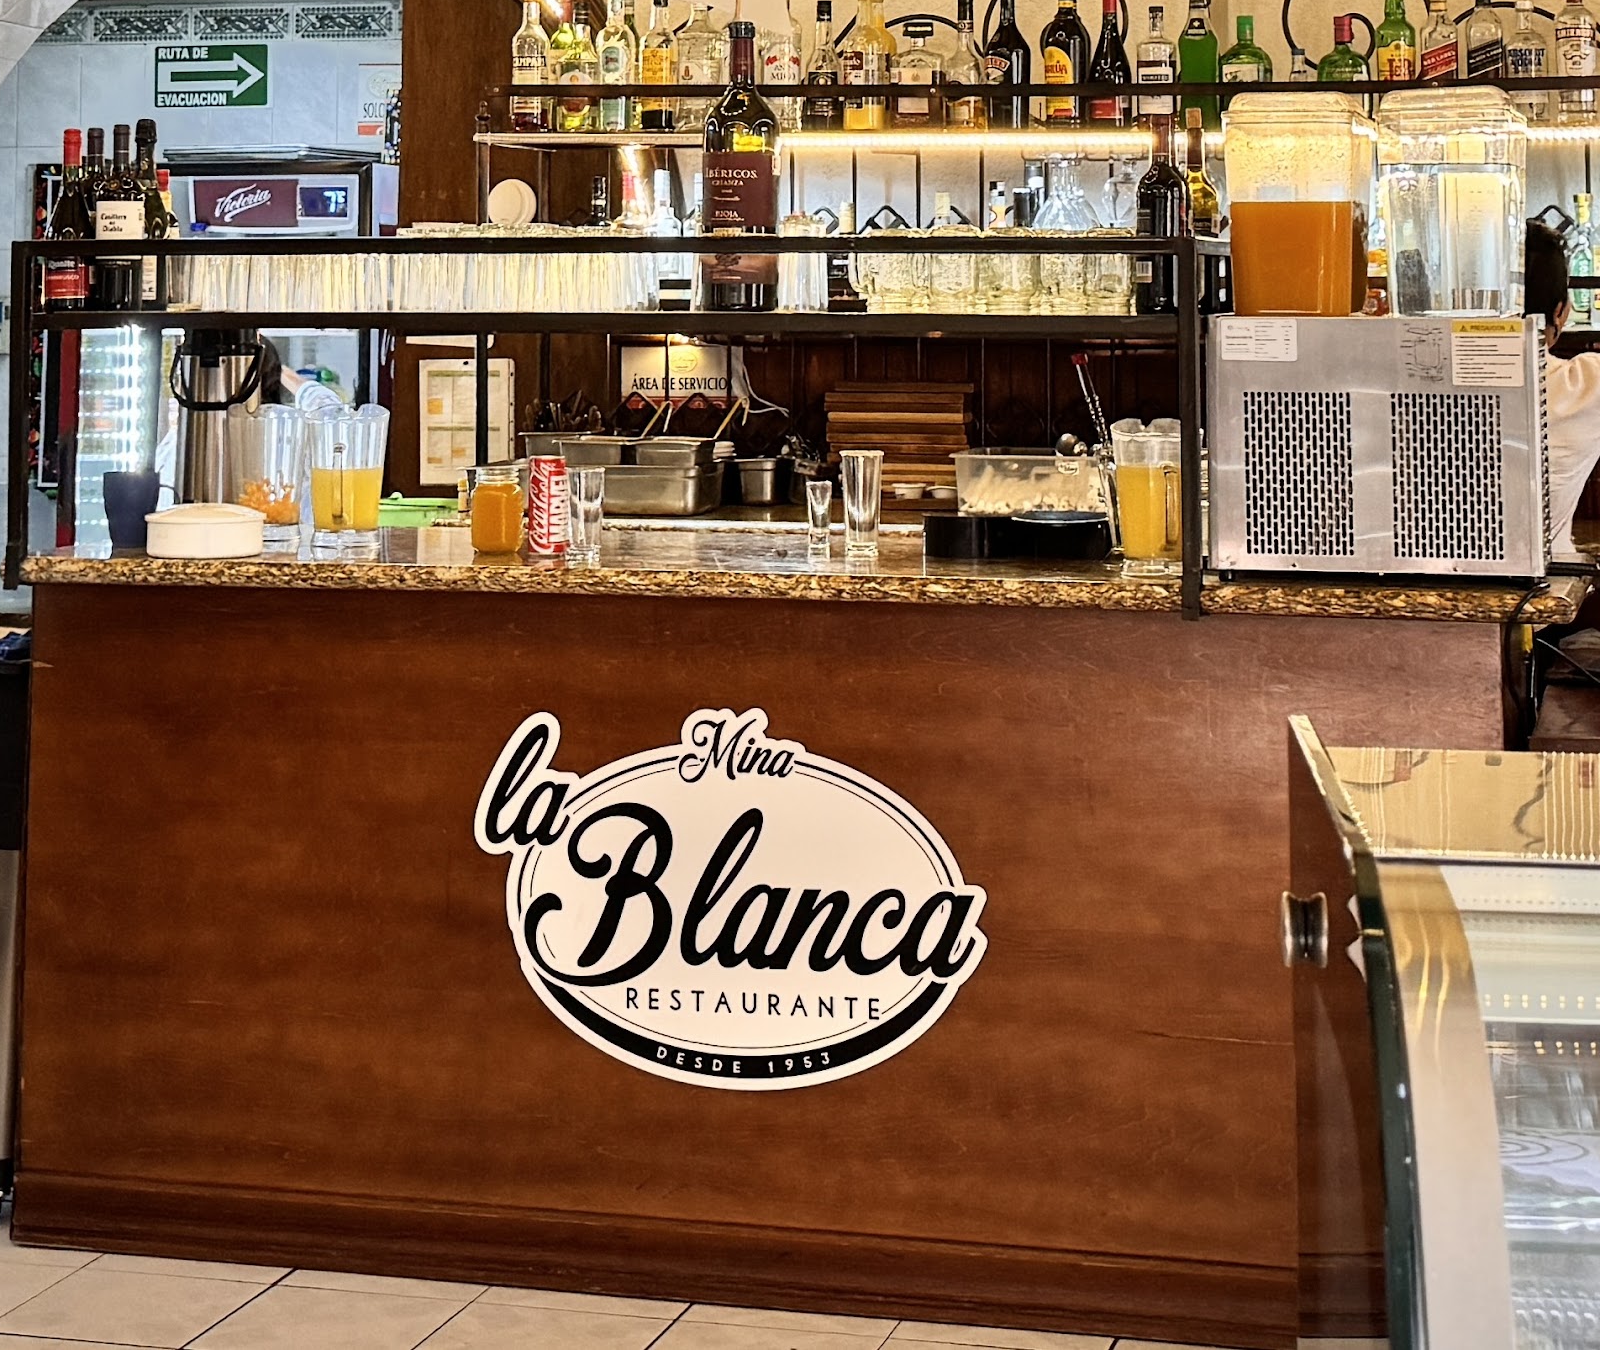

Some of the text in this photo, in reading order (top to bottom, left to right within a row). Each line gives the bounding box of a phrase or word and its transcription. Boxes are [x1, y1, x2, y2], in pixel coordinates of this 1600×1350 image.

[158, 46, 209, 60] RUTA DE
[157, 92, 228, 107] EVACUACION
[705, 167, 759, 179] IBÉRICOS
[214, 183, 272, 223] Victoria
[632, 373, 659, 391] ÁREA
[679, 717, 796, 783] Mina
[484, 723, 976, 988] la Blanca
[626, 987, 884, 1023] RESTAURANTE
[656, 1044, 833, 1075] DESDE 1953
